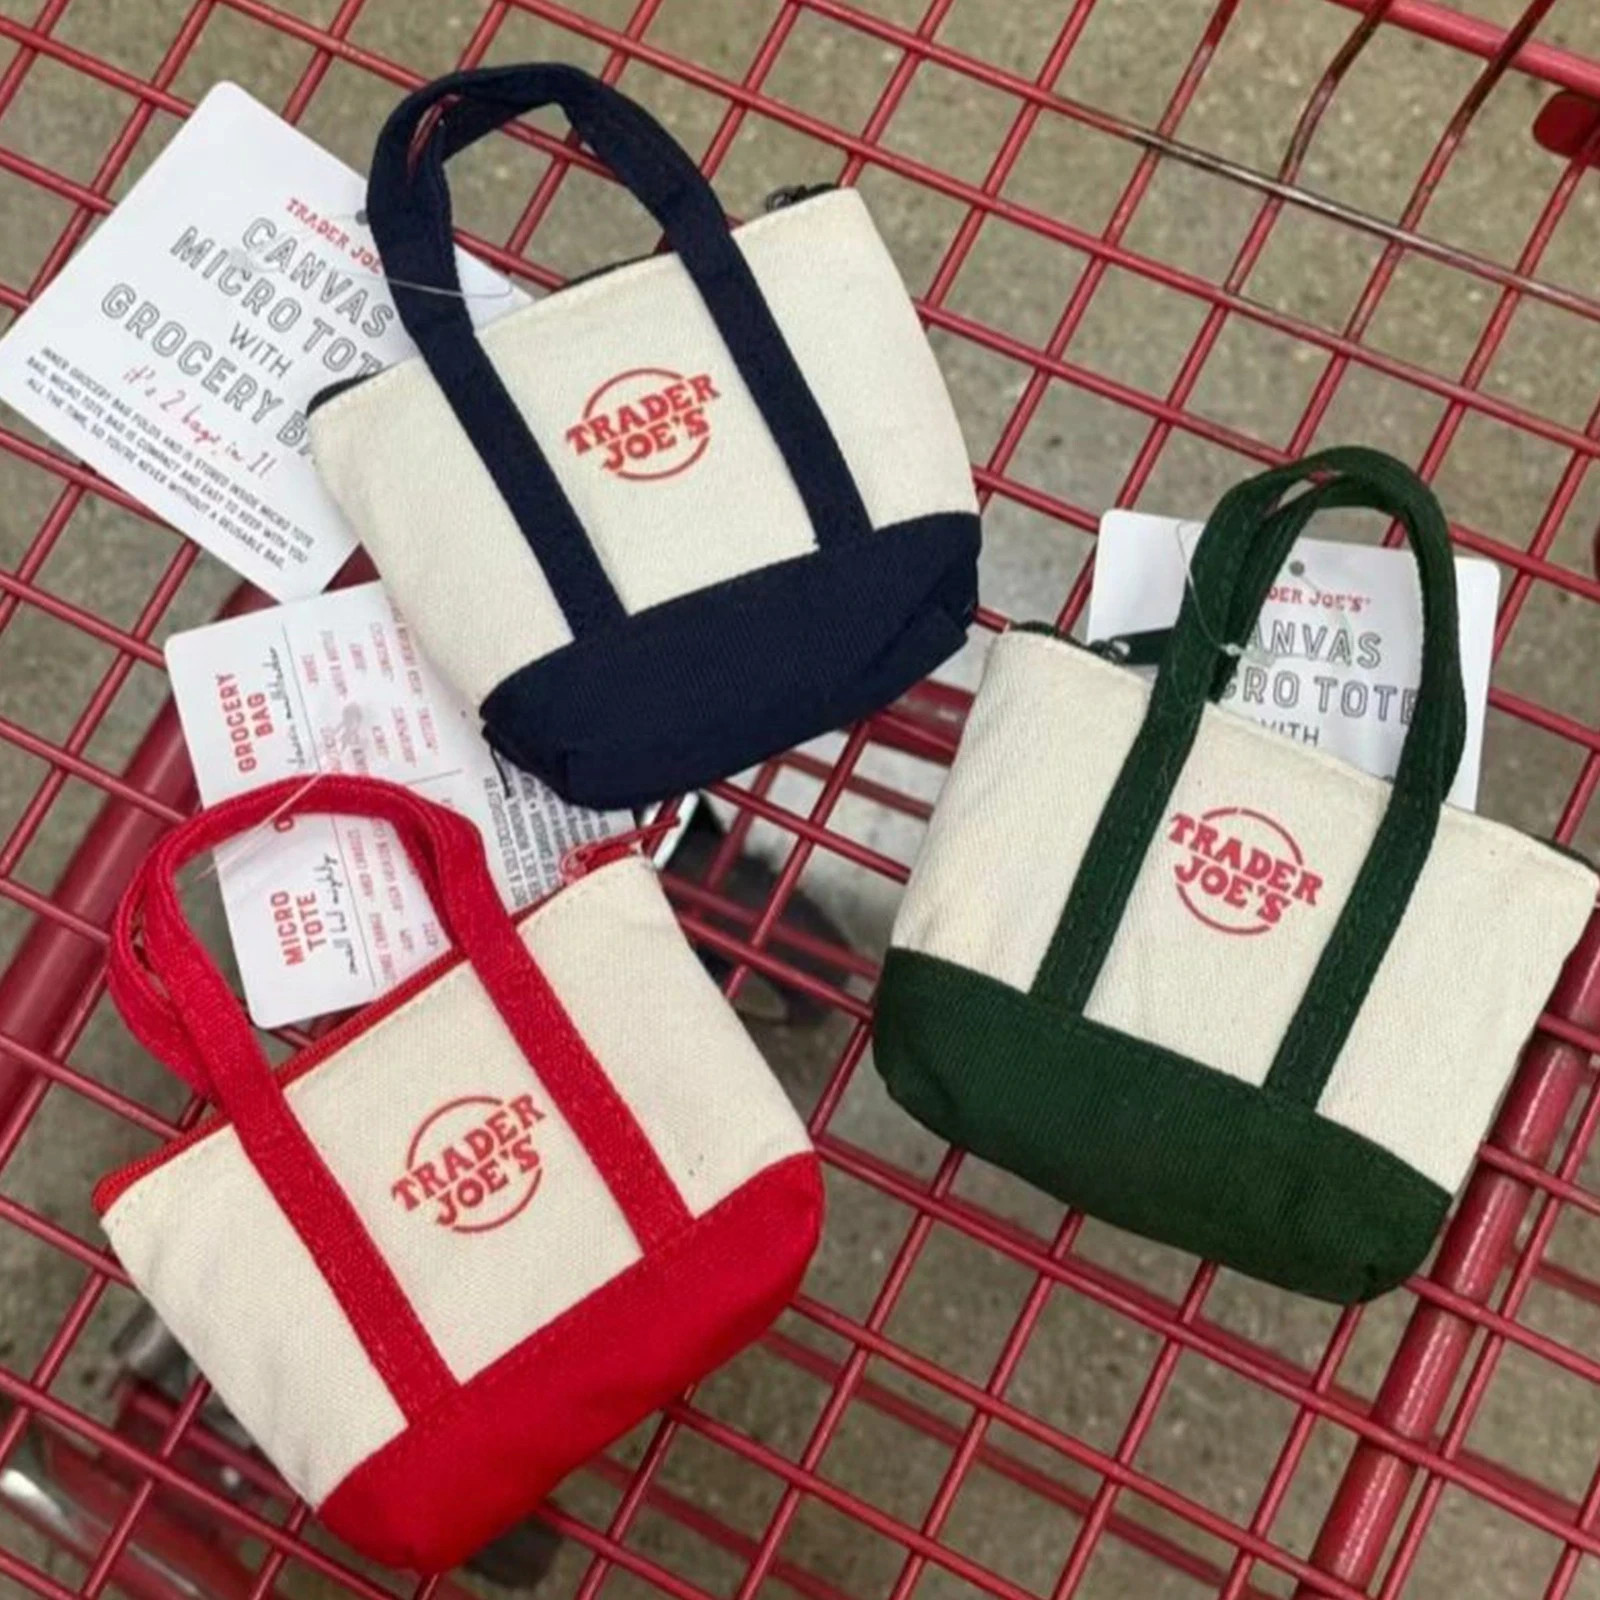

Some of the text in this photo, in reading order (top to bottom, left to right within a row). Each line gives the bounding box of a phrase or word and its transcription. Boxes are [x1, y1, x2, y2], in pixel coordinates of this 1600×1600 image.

[285, 197, 384, 275] TRADER JOE
[170, 225, 381, 380] MICRO TOT
[241, 217, 395, 338] CANVAS
[100, 283, 284, 425] GROCERY
[229, 322, 293, 378] WITH
[566, 374, 721, 455] TRADER
[602, 408, 710, 471] JOE'S
[160, 434, 183, 455] AND
[257, 503, 292, 532] MICRO
[1267, 587, 1366, 612] DER JOE'S
[212, 669, 260, 774] GROCERY
[245, 690, 275, 737] BAG
[1169, 812, 1323, 906] TRADER
[1174, 855, 1291, 923] JOE'S
[267, 889, 306, 967] MICRO
[294, 890, 327, 951] TOTE
[391, 1094, 546, 1211] TRADER
[437, 1134, 540, 1225] JOE'S
